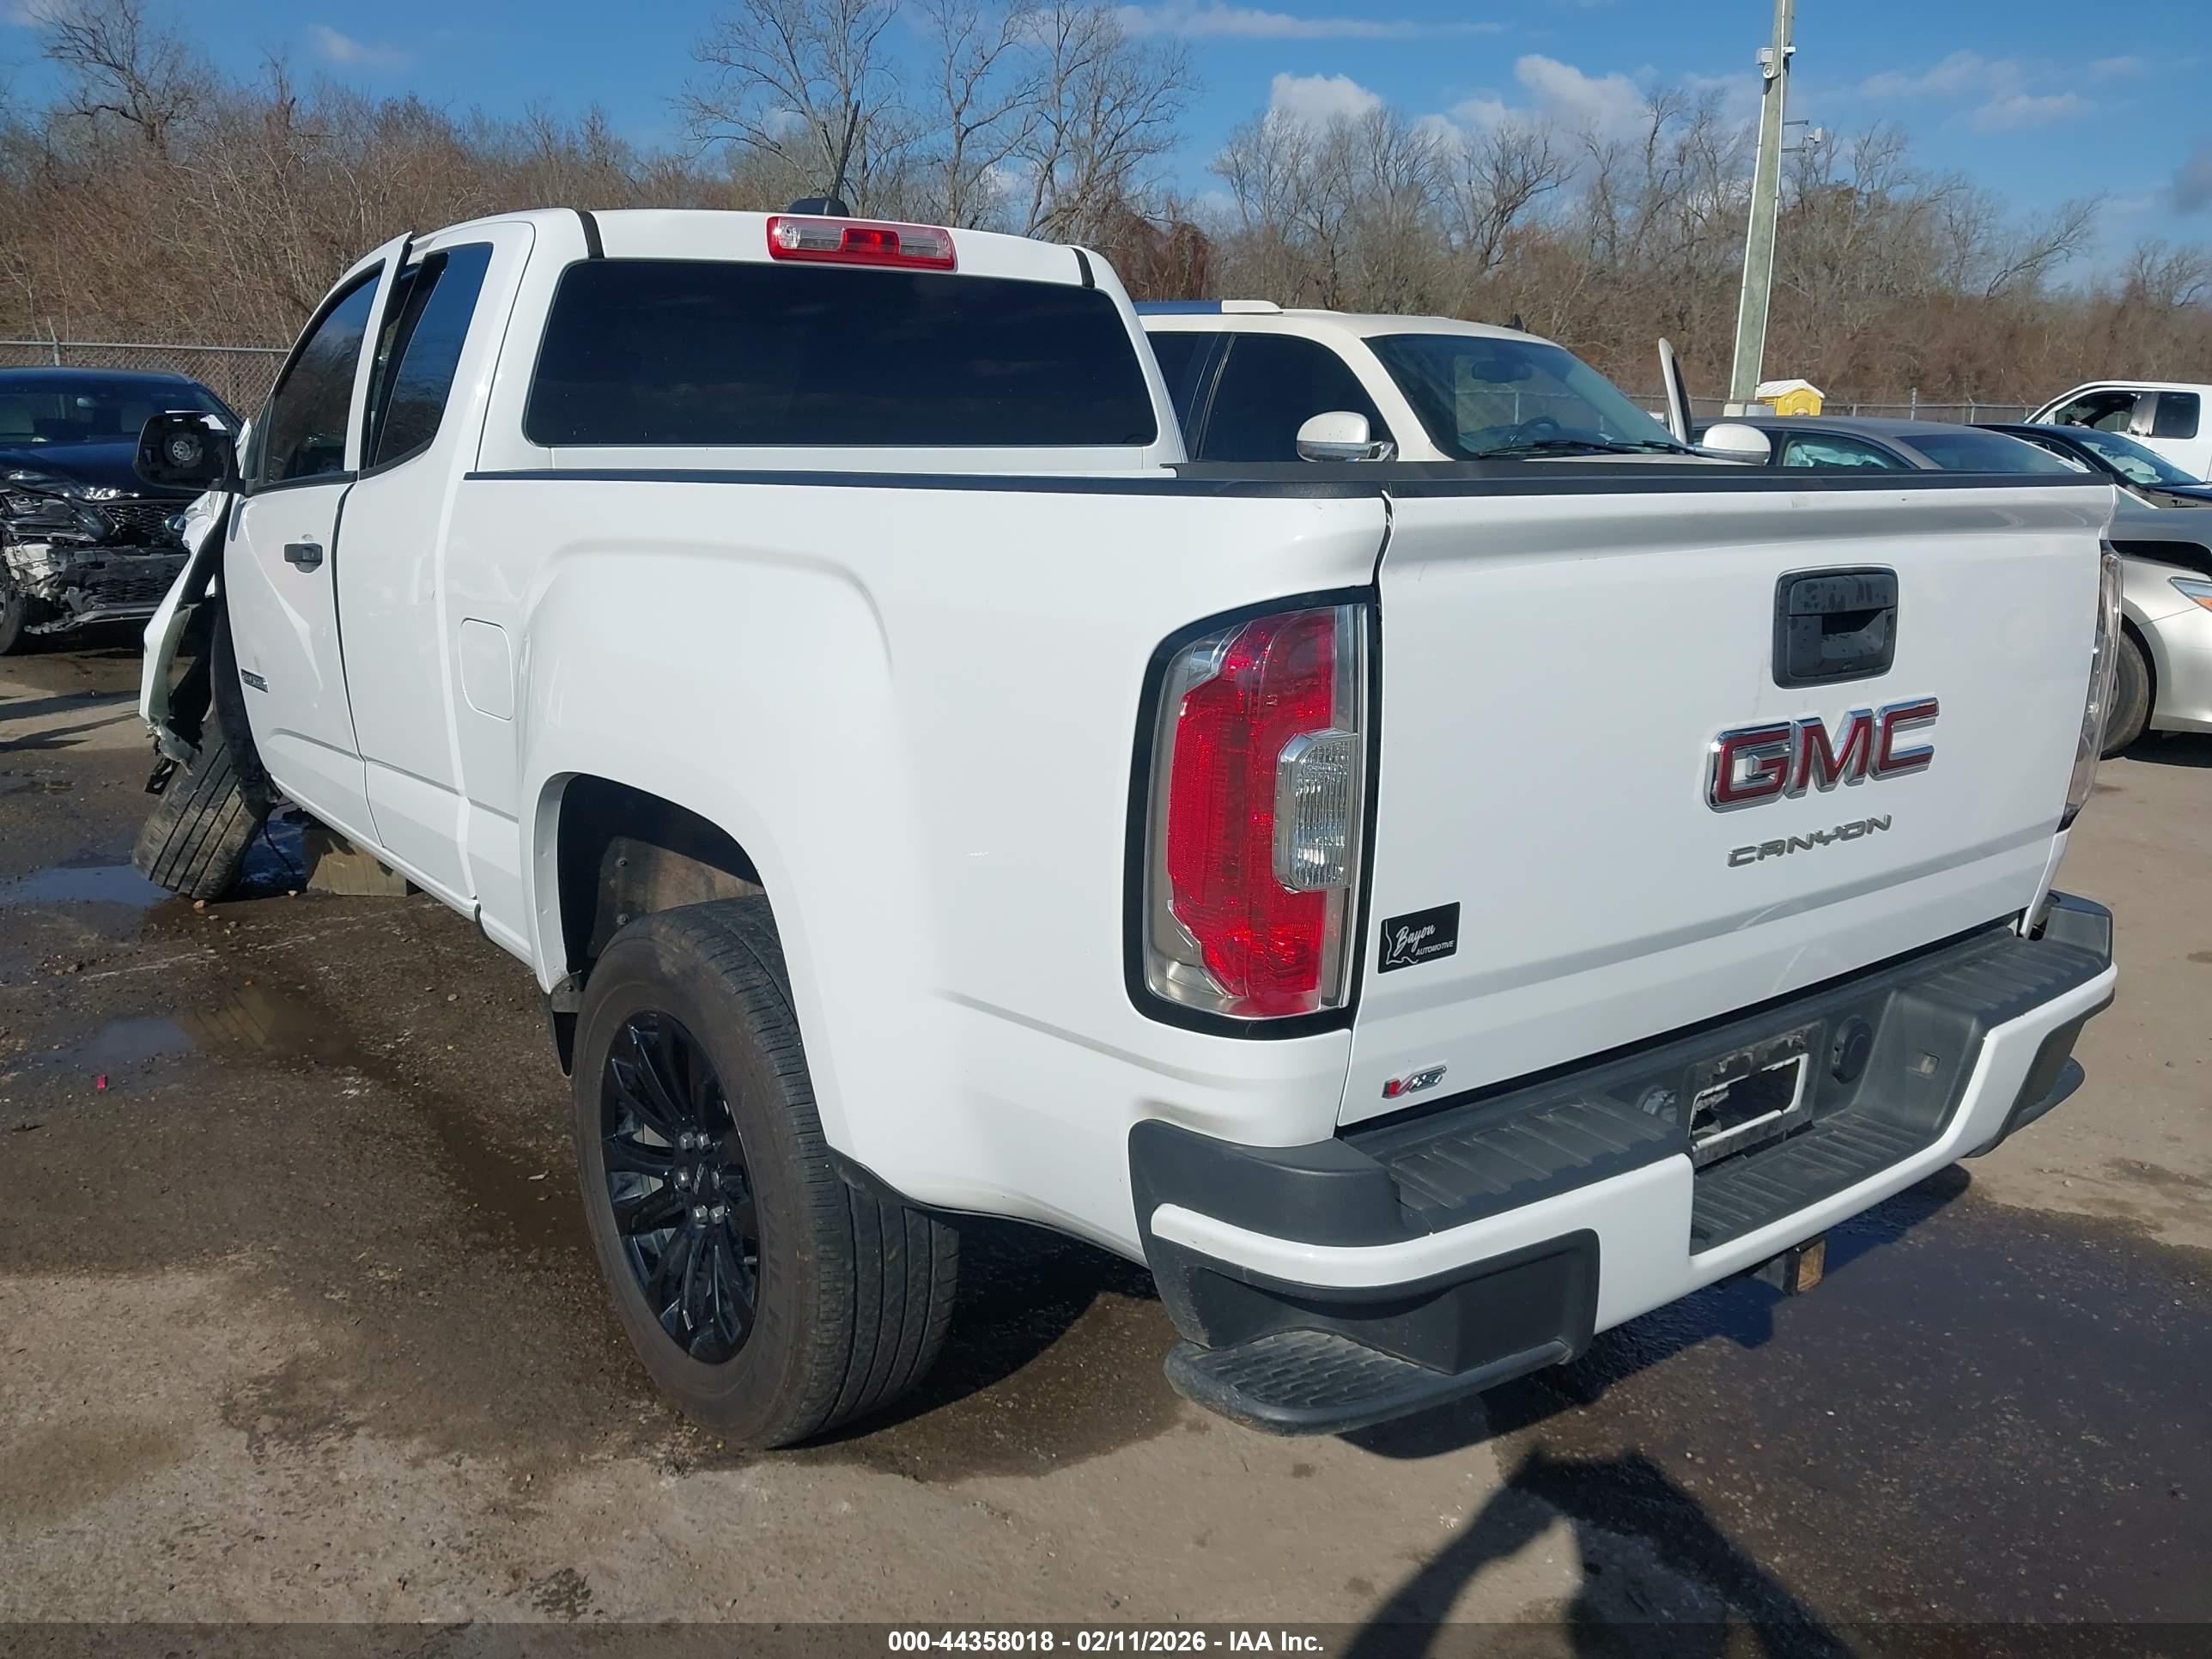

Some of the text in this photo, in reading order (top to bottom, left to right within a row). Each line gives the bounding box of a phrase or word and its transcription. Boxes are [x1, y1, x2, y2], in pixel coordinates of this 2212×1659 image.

[1705, 696, 1939, 813] GMC
[1728, 814, 1892, 867] CANYON
[1394, 925, 1436, 957] Bayou
[1416, 940, 1455, 956] AUTOMOTIVE
